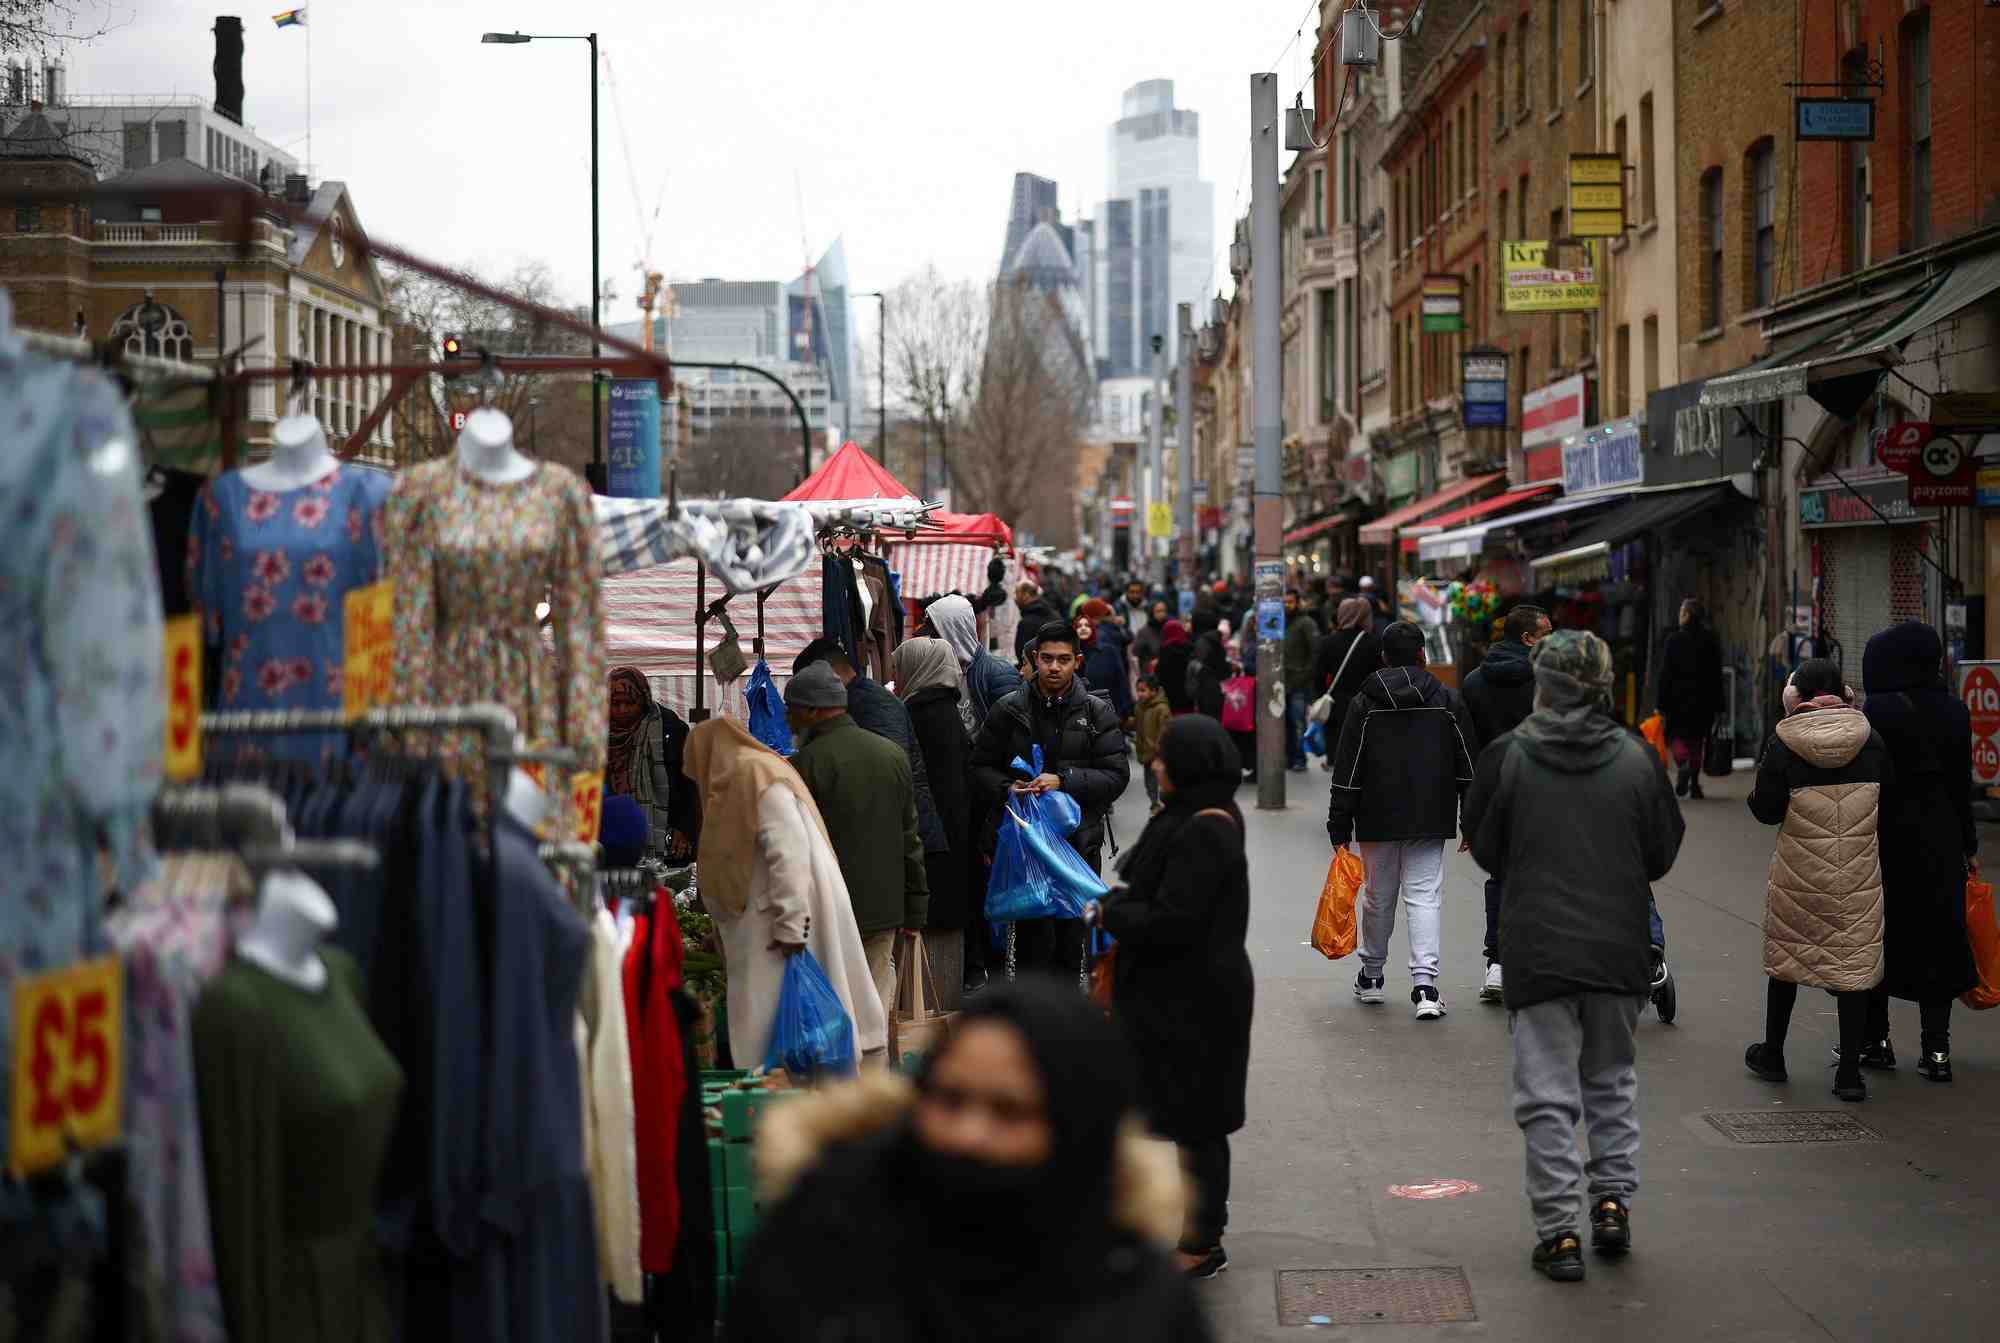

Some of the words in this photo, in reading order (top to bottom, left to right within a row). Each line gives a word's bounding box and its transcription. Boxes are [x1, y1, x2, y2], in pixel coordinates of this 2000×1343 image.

[1509, 289, 1530, 298] 020
[1913, 486, 1969, 500] payzone
[1967, 675, 1999, 713] ria
[1975, 741, 1998, 765] ria
[30, 990, 109, 1131] £5
